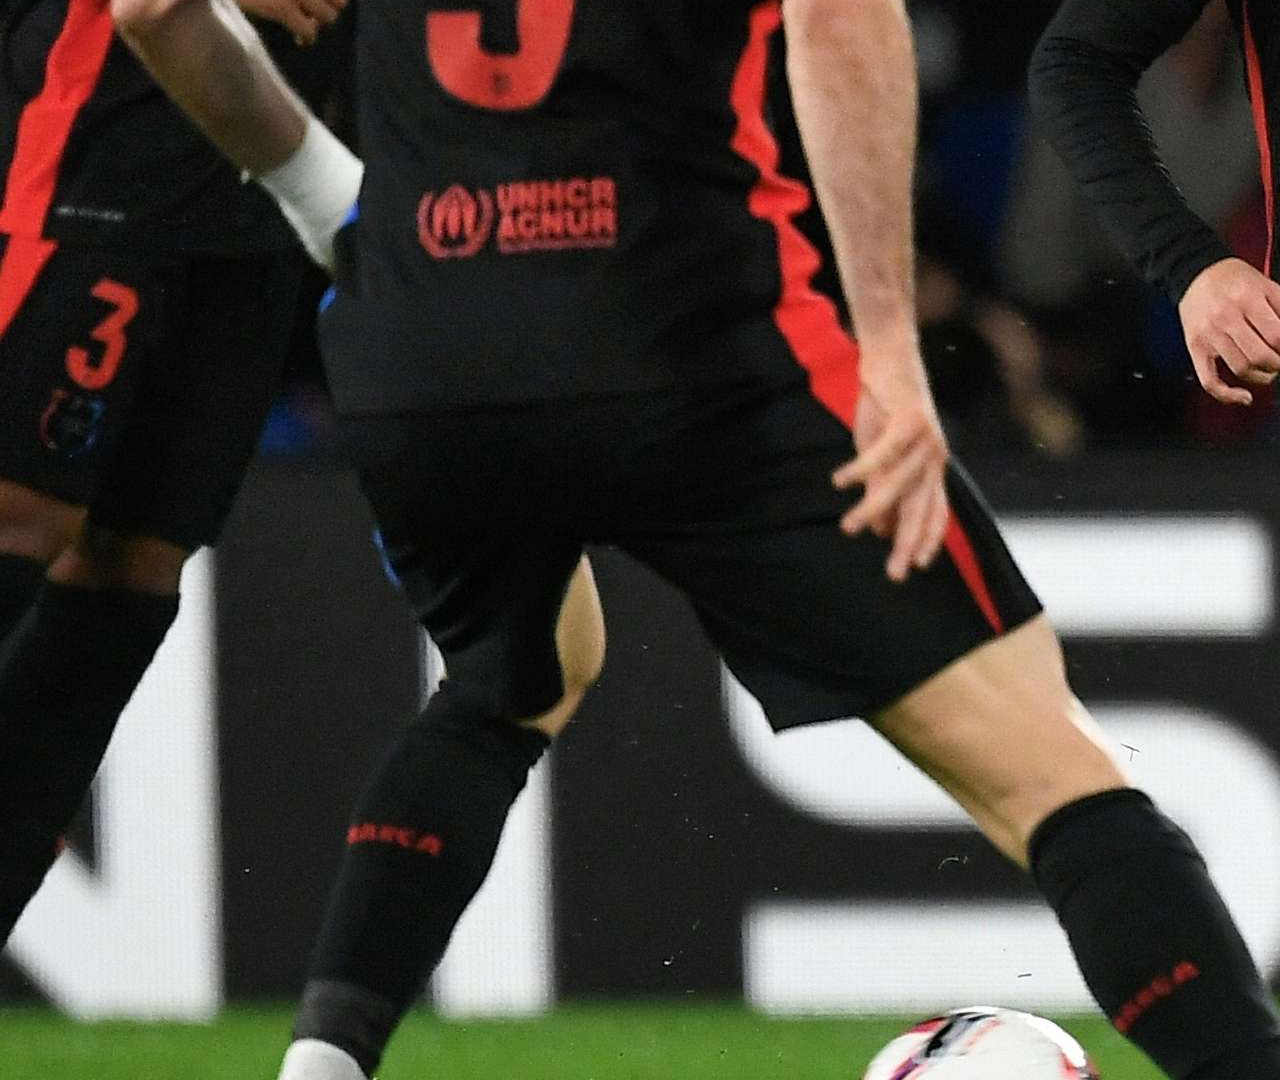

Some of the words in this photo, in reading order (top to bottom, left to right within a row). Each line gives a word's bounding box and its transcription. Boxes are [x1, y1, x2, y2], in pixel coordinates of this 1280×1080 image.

[496, 177, 616, 211] UNHCR
[497, 208, 617, 238] ACNUR
[65, 278, 140, 389] 3
